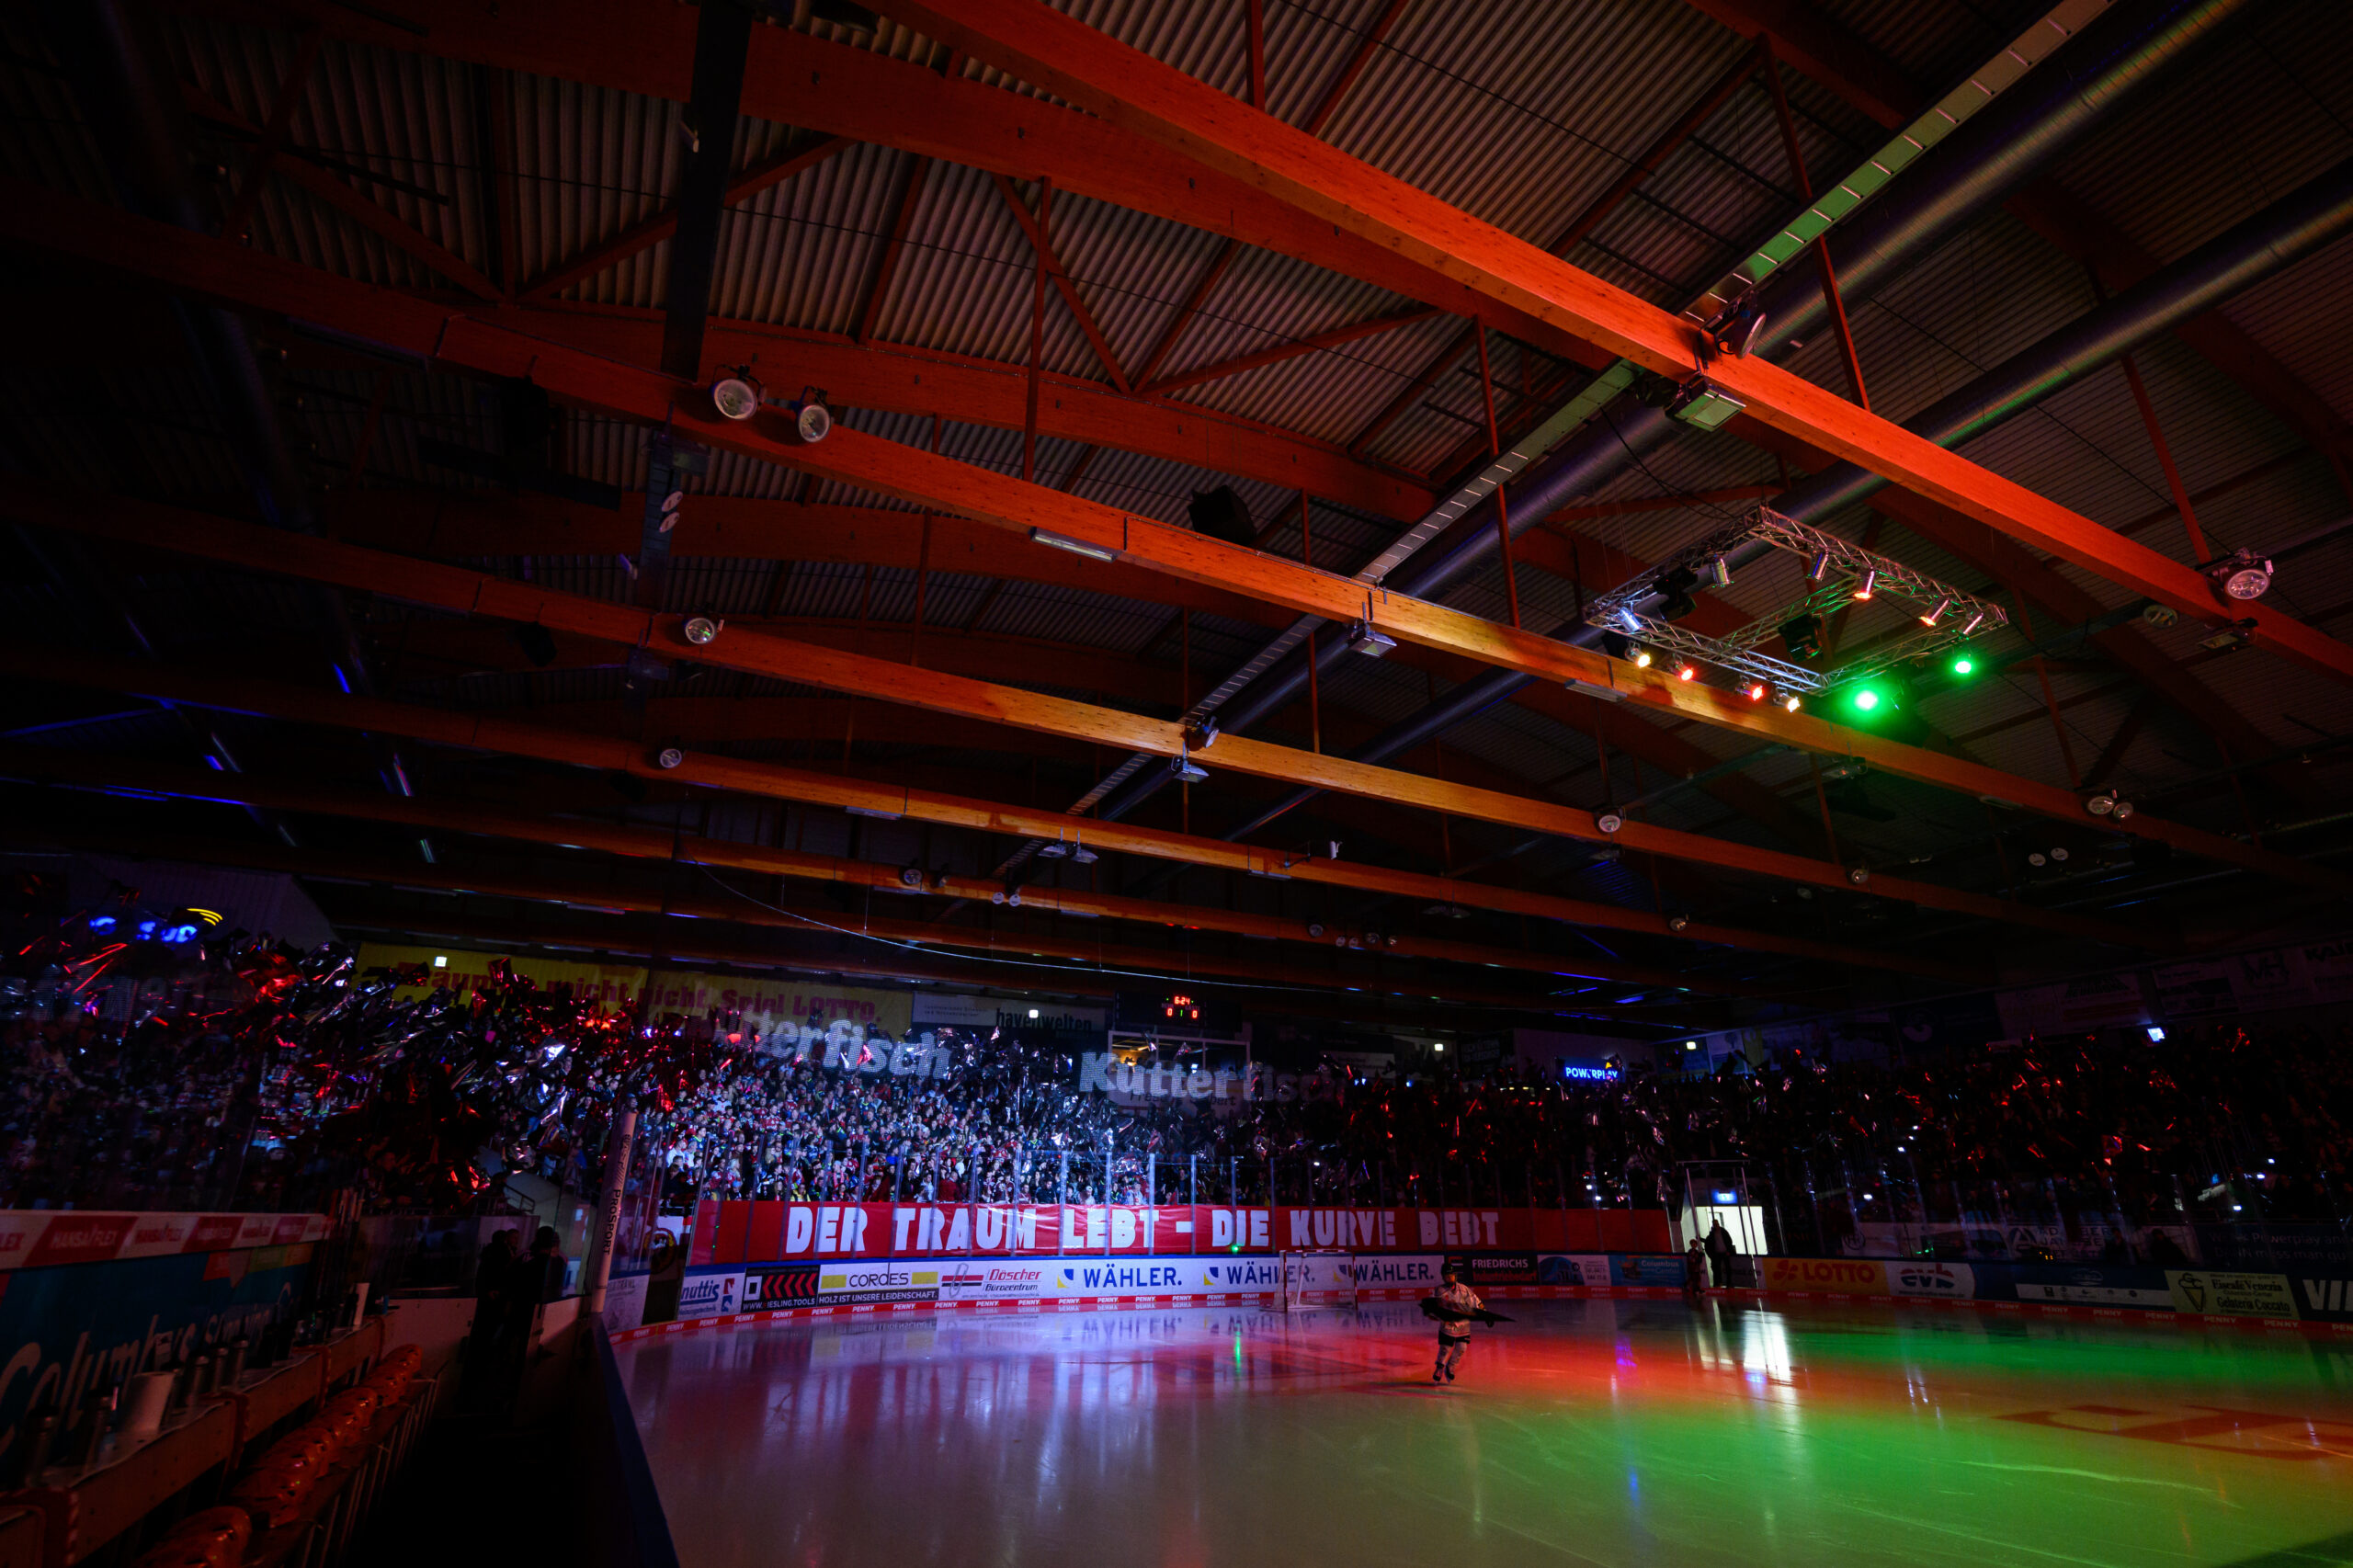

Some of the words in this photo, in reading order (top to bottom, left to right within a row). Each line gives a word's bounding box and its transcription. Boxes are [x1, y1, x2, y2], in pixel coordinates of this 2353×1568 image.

[792, 994, 881, 1023] LOTTO.
[996, 1007, 1092, 1030] havenwelten
[1167, 1007, 1173, 1017] 0
[1192, 1010, 1198, 1018] 0
[602, 1189, 621, 1255] PROSPORT
[786, 1206, 868, 1253] DER
[894, 1207, 1037, 1251] TRAUM
[1063, 1208, 1159, 1248] LEBT
[1211, 1210, 1269, 1246] DIE
[1290, 1210, 1396, 1247] KURVE
[1419, 1210, 1499, 1246] BEBT
[1355, 1260, 1434, 1281] WÄHLER.
[1472, 1258, 1529, 1268] FRIEDRICHS
[1802, 1262, 1875, 1283] LOTTO
[989, 1268, 1041, 1281] Döscher
[1083, 1263, 1182, 1289] WÄHLER.
[819, 1295, 837, 1304] HOLZ
[838, 1294, 850, 1302] IST
[851, 1292, 881, 1301] UNSERE
[881, 1290, 938, 1301] LEIDENSCHAFT.
[985, 1282, 1038, 1292] Bürozentrum
